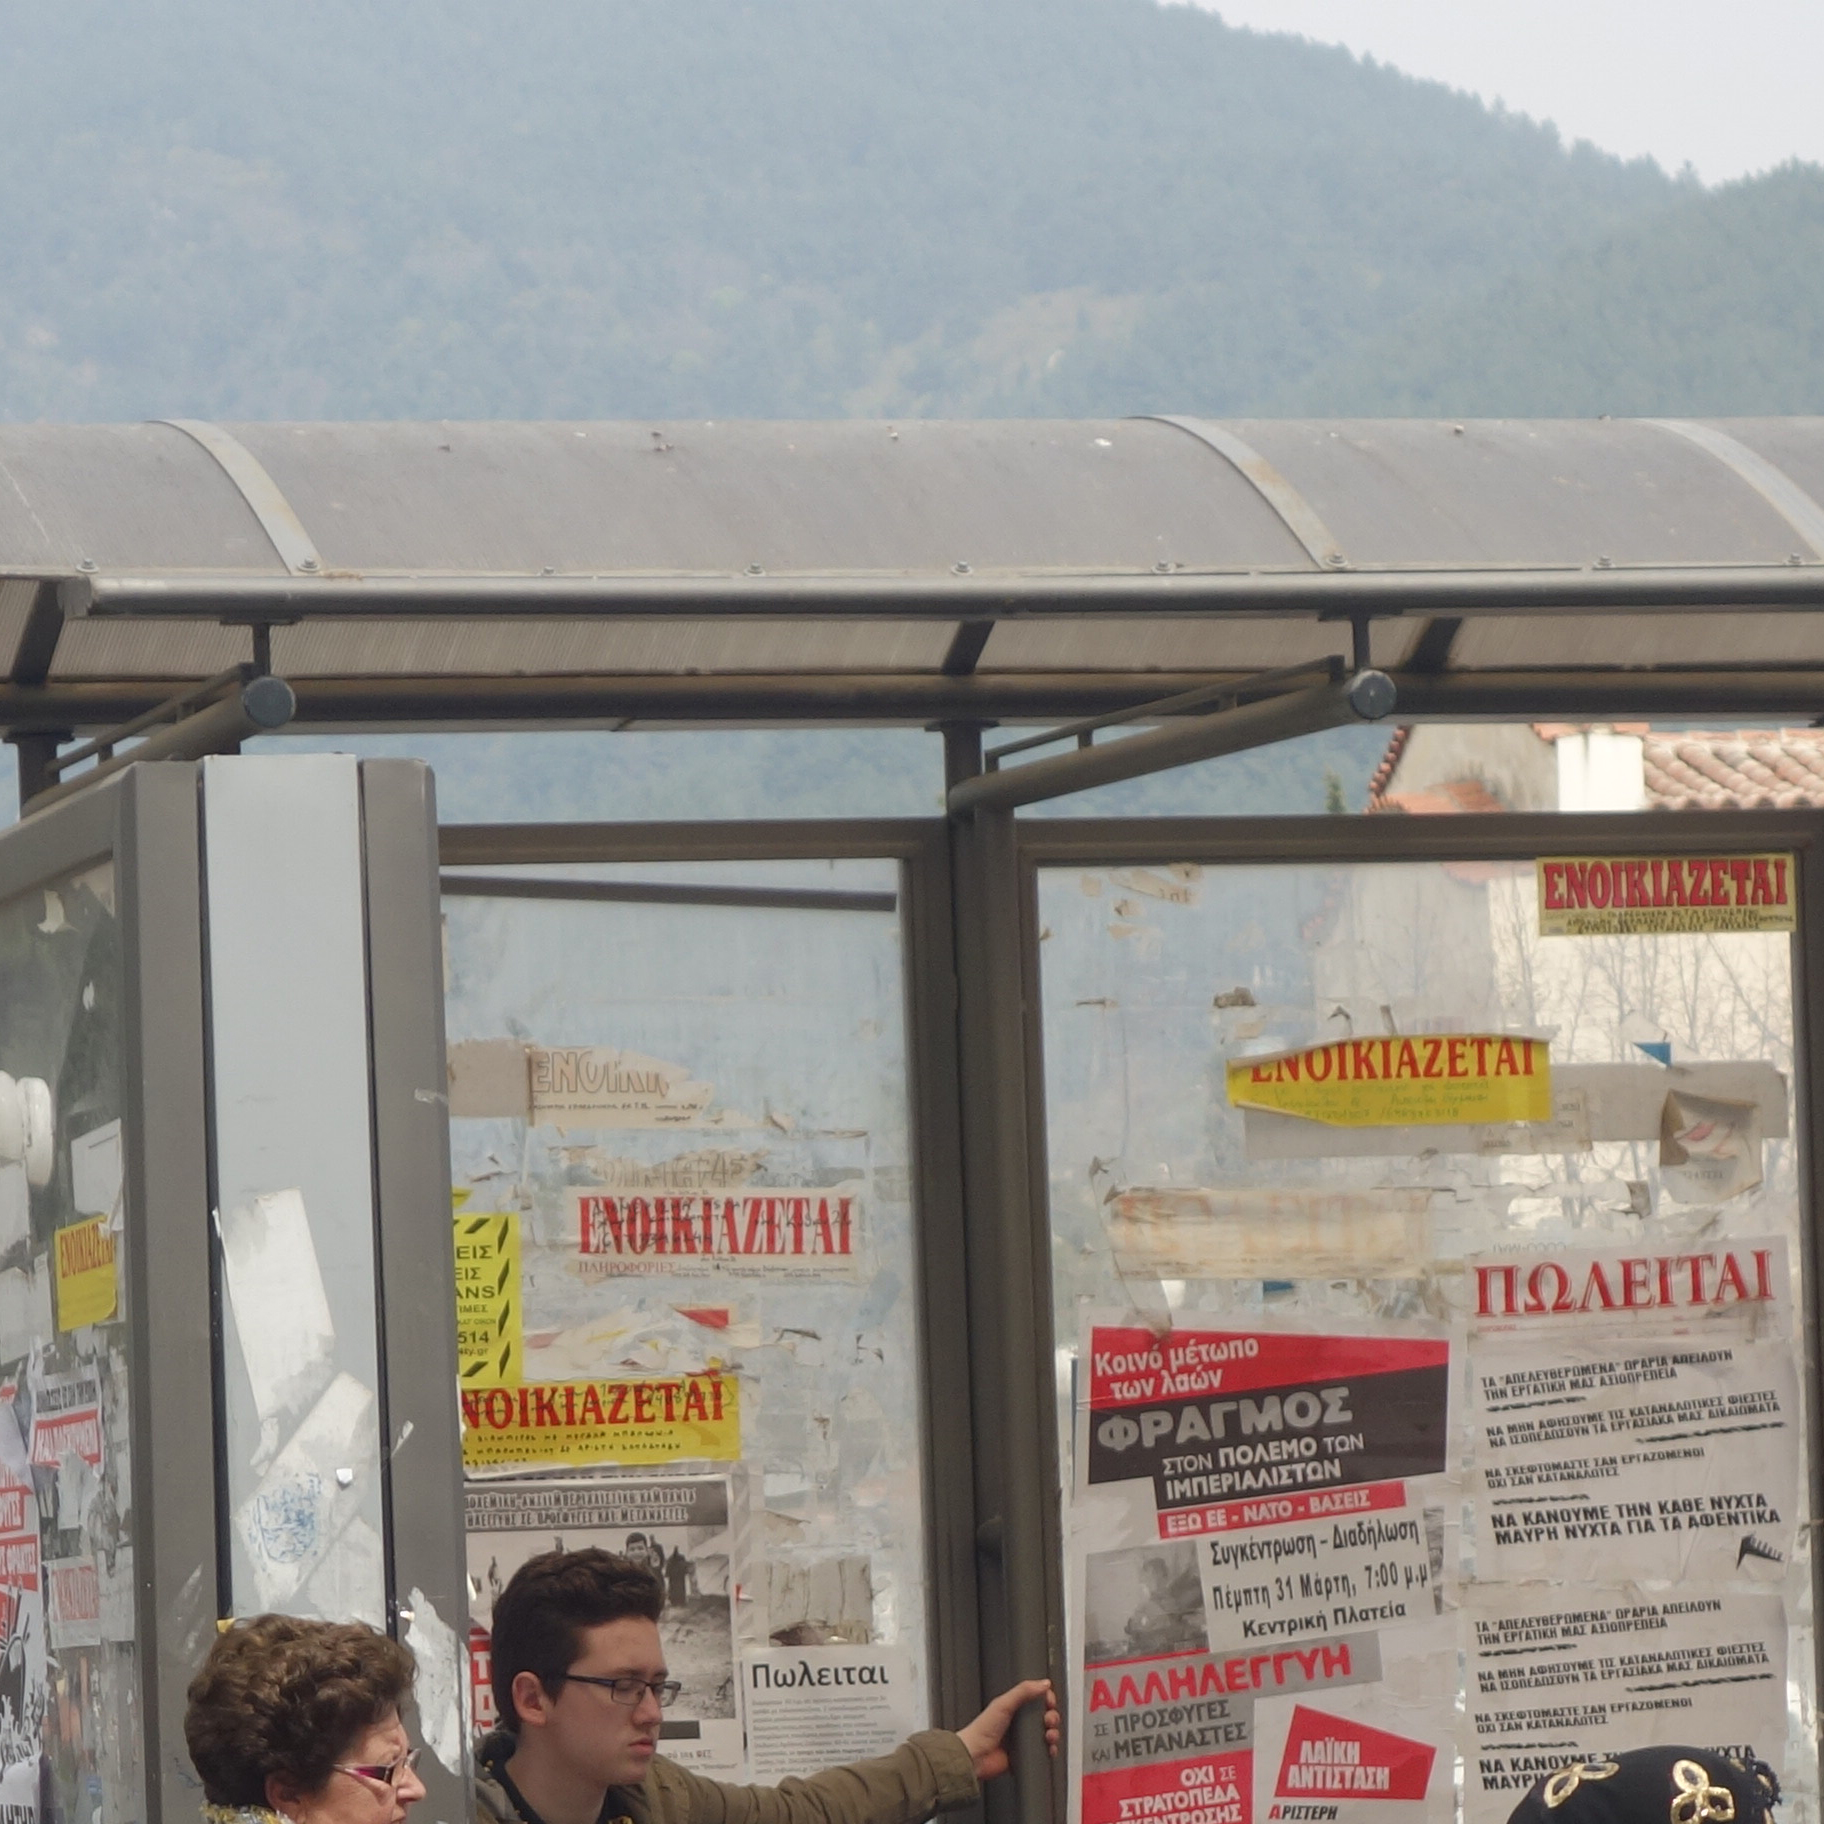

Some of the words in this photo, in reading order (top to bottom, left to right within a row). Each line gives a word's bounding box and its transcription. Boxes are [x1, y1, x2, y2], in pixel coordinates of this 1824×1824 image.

[1543, 858, 1788, 910] ΕΝΟΙΚΙΑΖΕΤΑΙ
[578, 1195, 855, 1255] ΕΝΟΙΚΙΑΖΕΤΑΙ
[578, 1261, 675, 1274] ΠΛΗΡΟΦΟΡΙΕΣ
[1473, 1250, 1775, 1317] ΠΩΛΕΙΤΑΙ
[457, 1304, 488, 1313] ΙΜΕΣ
[1095, 1347, 1164, 1377] Κοινό
[1170, 1338, 1260, 1375] μέτωπο
[1481, 1377, 1497, 1388] ΤΑ
[1624, 1356, 1669, 1372] ΩΡΑΡΙΑ
[1672, 1349, 1733, 1365] ΑΠΕΙΛΟΥΝ
[1110, 1380, 1156, 1400] των
[1161, 1367, 1224, 1396] λαών
[1484, 1387, 1508, 1401] ΤΗΝ
[1511, 1380, 1567, 1398] ΕΡΓΑΤΙΚΗ
[1570, 1377, 1595, 1390] ΜΑΣ
[1600, 1367, 1678, 1388] ΑΞΙΟΠΡΕΠΕΙΑ
[1097, 1386, 1354, 1451] ΦΡΑΓΜΟΣ
[1486, 1425, 1504, 1437] ΝΑ
[1507, 1420, 1535, 1434] ΜΗΝ
[1539, 1411, 1605, 1431] ΑΦΗΣΟΥΜΕ
[1608, 1406, 1626, 1420] ΤΙΣ
[1629, 1396, 1724, 1419] ΚΑΤΑΝΑΛΩΤΙΚΕΣ
[1727, 1389, 1778, 1405] ΦΙΕΣΤΕΣ
[1489, 1436, 1507, 1448] ΝΑ
[1510, 1424, 1590, 1446] ΙΣΟΠΕΔΩΣΟΥΝ
[1592, 1421, 1609, 1434] ΤΑ
[1611, 1413, 1675, 1432] ΕΡΓΑΣΙΑΚΑ
[1677, 1409, 1704, 1423] ΜΑΣ
[1708, 1400, 1781, 1420] ΔΙΚΑΙΩΜΑΤΑ
[1162, 1453, 1213, 1476] ΣΤΟΝ
[1219, 1436, 1318, 1469] ΠΟΛΕΜΟ
[1323, 1433, 1365, 1454] ΤΩΝ
[1485, 1467, 1502, 1479] ΝΑ
[1505, 1458, 1591, 1477] ΣΚΕΦΤΟΜΑΣΤΕ
[1594, 1455, 1618, 1468] ΣΑΝ
[1621, 1447, 1705, 1466] ΕΡΓΑΖΟΜΕΝΟΙ
[1166, 1459, 1342, 1500] ΙΜΠΕΡΙΑΛΙΣΤΩΝ
[1487, 1477, 1507, 1489] ΟΧΙ
[1510, 1475, 1534, 1487] ΣΑΝ
[1537, 1466, 1620, 1484] ΚΑΤΑΝΑΛΩΤΕΣ
[1166, 1514, 1202, 1533] ΕΞΩ
[1206, 1509, 1226, 1527] ΕΕ
[1243, 1500, 1293, 1523] ΝΑΤΟ
[1310, 1489, 1371, 1513] ΒΑΣΕΙΣ
[1491, 1513, 1517, 1529] ΝΑ
[1522, 1505, 1611, 1527] ΚΑΝΟΥΜΕ
[1616, 1502, 1652, 1519] ΤΗΝ
[1659, 1496, 1706, 1515] ΚΑΘΕ
[1710, 1492, 1769, 1511] ΝΥΧΤΑ
[1494, 1525, 1559, 1546] ΜΑΥΡΗ
[1564, 1519, 1622, 1540] ΝΥΧΤΑ
[1628, 1518, 1656, 1534] ΓΙΑ
[1659, 1516, 1681, 1531] ΤΑ
[1688, 1508, 1782, 1529] ΑΦΕΝΤΙΚΑ
[1210, 1534, 1317, 1570] Συγκέντρωση
[1333, 1518, 1420, 1550] Διαδήλωση
[1212, 1584, 1272, 1615] Πέμπτη
[1276, 1575, 1294, 1600] 31
[1300, 1573, 1357, 1602] Μάρτη,
[1364, 1561, 1399, 1590] 7:00
[1243, 1612, 1328, 1638] Κεντρική
[1333, 1602, 1407, 1626] Πλατεία
[1476, 1621, 1490, 1633] ΤΑ
[1615, 1606, 1659, 1620] ΩΡΑΡΙΑ
[1662, 1599, 1722, 1615] ΑΠΕΙΛΟΥΝ
[1478, 1632, 1501, 1645] ΤΗΝ
[1504, 1626, 1558, 1644] ΕΡΓΑΤΙΚΗ
[1561, 1623, 1586, 1638] ΜΑΣ
[1591, 1617, 1668, 1635] ΑΞΙΟΠΡΕΠΕΙΑ
[752, 1660, 889, 1689] Πωλειται
[1089, 1643, 1352, 1713] ΑΛΛΗΛΕΓΓΥΗ
[1478, 1670, 1495, 1682] ΝΑ
[1497, 1666, 1526, 1680] ΜΗΝ
[1529, 1659, 1596, 1677] ΑΦΗΣΟΥΜΕ
[1598, 1656, 1616, 1669] ΤΙΣ
[1619, 1647, 1712, 1667] ΚΑΤΑΝΑΛΩΤΙΚΕΣ
[1716, 1641, 1767, 1656] ΦΙΕΣΤΕΣ
[1480, 1682, 1498, 1694] ΝΑ
[1500, 1672, 1581, 1691] ΙΣΟΠΕΔΩΣΟΥΝ
[1583, 1670, 1598, 1682] ΤΑ
[1601, 1662, 1663, 1681] ΕΡΓΑΣΙΑΚΑ
[1666, 1658, 1693, 1673] ΜΑΣ
[1696, 1652, 1770, 1670] ΔΙΚΑΙΩΜΑΤΑ
[1094, 1722, 1109, 1737] ΣΕ
[1114, 1699, 1231, 1735] ΠΡΟΣΦΥΓΕΣ
[1475, 1712, 1492, 1724] ΝΑ
[1494, 1706, 1581, 1722] ΣΚΕΦΤΟΜΑΣΤΕ
[1582, 1703, 1607, 1715] ΣΑΝ
[1610, 1697, 1693, 1713] ΕΡΓΑΖΟΜΕΝΟΙ
[1477, 1722, 1497, 1734] ΟΧΙ
[1500, 1720, 1524, 1733] ΣΑΝ
[1526, 1714, 1609, 1731] ΚΑΤΑΝΑΛΩΤΕΣ
[1092, 1747, 1112, 1763] ΚΑΙ
[1114, 1722, 1248, 1760] ΜΕΤΑΝΑΣΤΕΣ
[1299, 1737, 1360, 1765] ΛΑΪΚΗ
[1180, 1765, 1215, 1787] ΟΧΙ
[1219, 1765, 1237, 1782] ΣΕ
[1286, 1765, 1390, 1791] ΑΝΤΙΣΤΑΣΗ
[1479, 1758, 1508, 1775] ΝΑ
[1119, 1783, 1241, 1819] ΣΤΡΑΤΟΠΕΔΑ
[1268, 1804, 1338, 1821] ΑΡΙΣΤΕΡΗ
